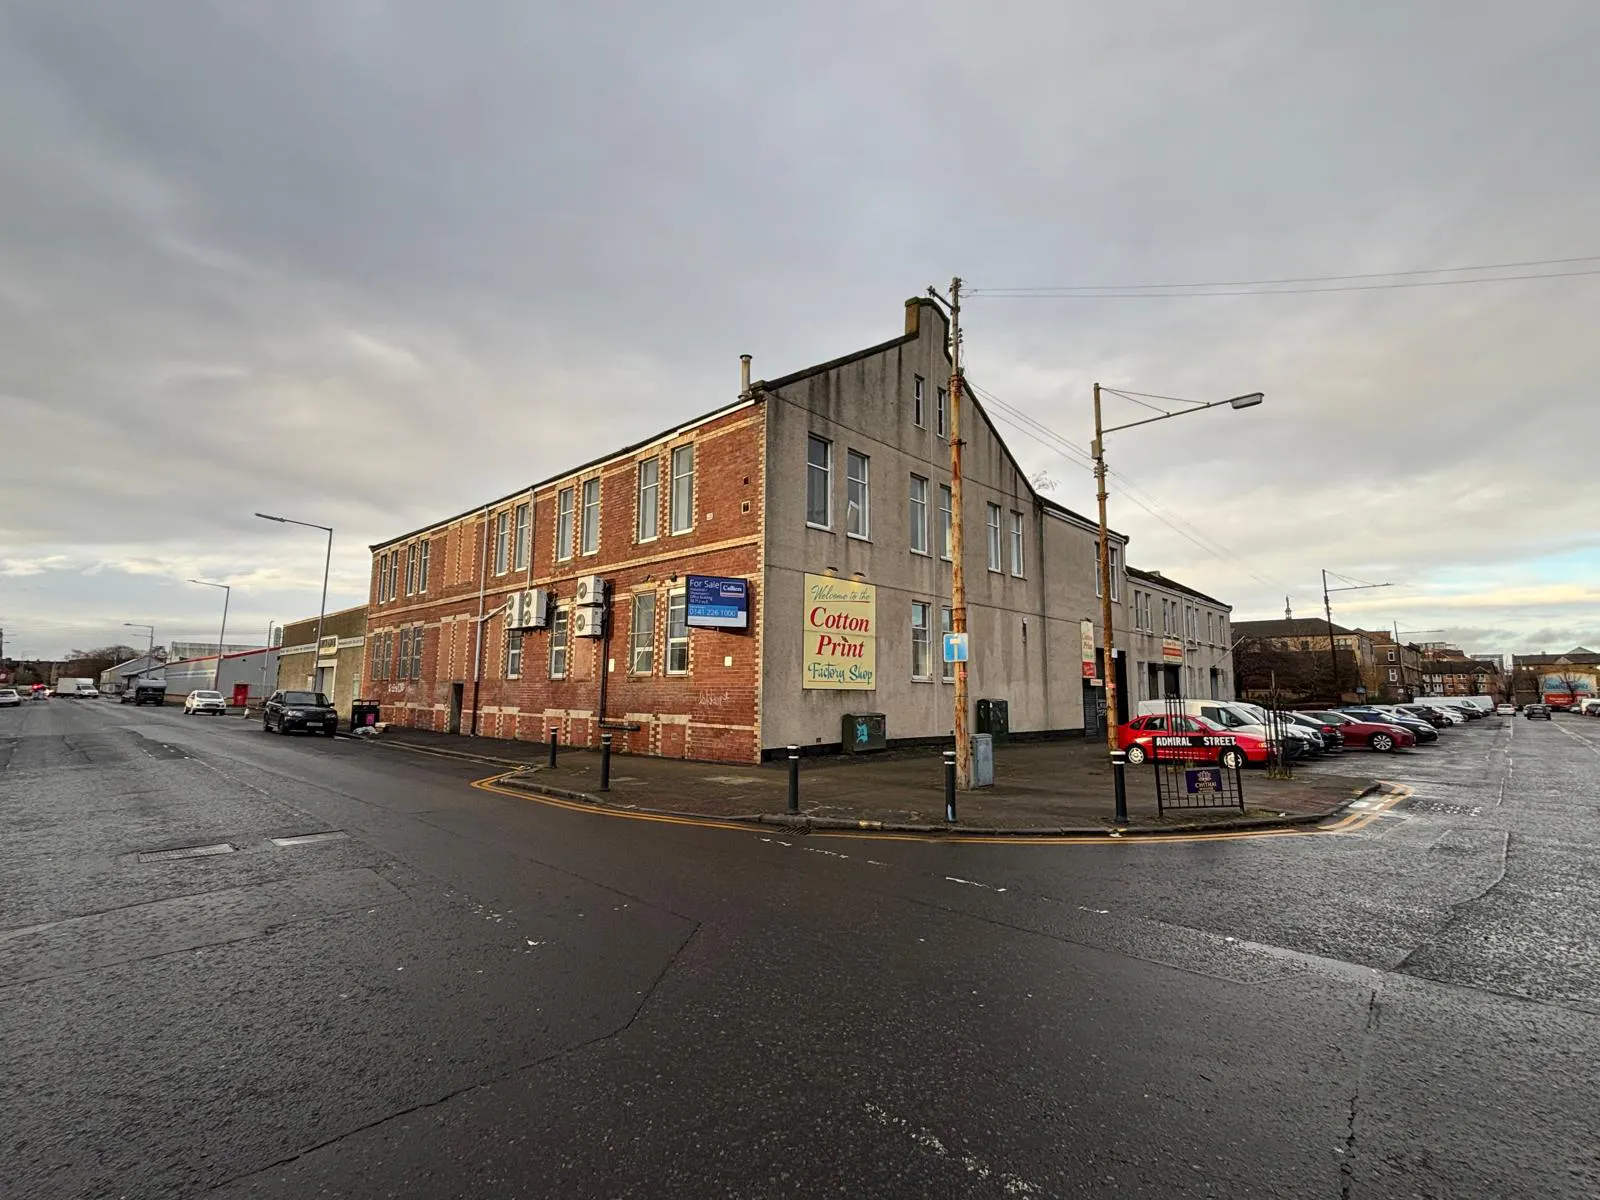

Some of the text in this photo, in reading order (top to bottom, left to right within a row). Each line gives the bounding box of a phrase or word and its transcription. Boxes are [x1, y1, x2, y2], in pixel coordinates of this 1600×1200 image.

[704, 581, 720, 589] Sale
[811, 584, 871, 600] Welcome to the
[810, 606, 870, 632] Cotton
[816, 634, 865, 658] Print
[808, 662, 873, 685] Factory Shop
[1156, 736, 1236, 746] ADMIRAL STREET
